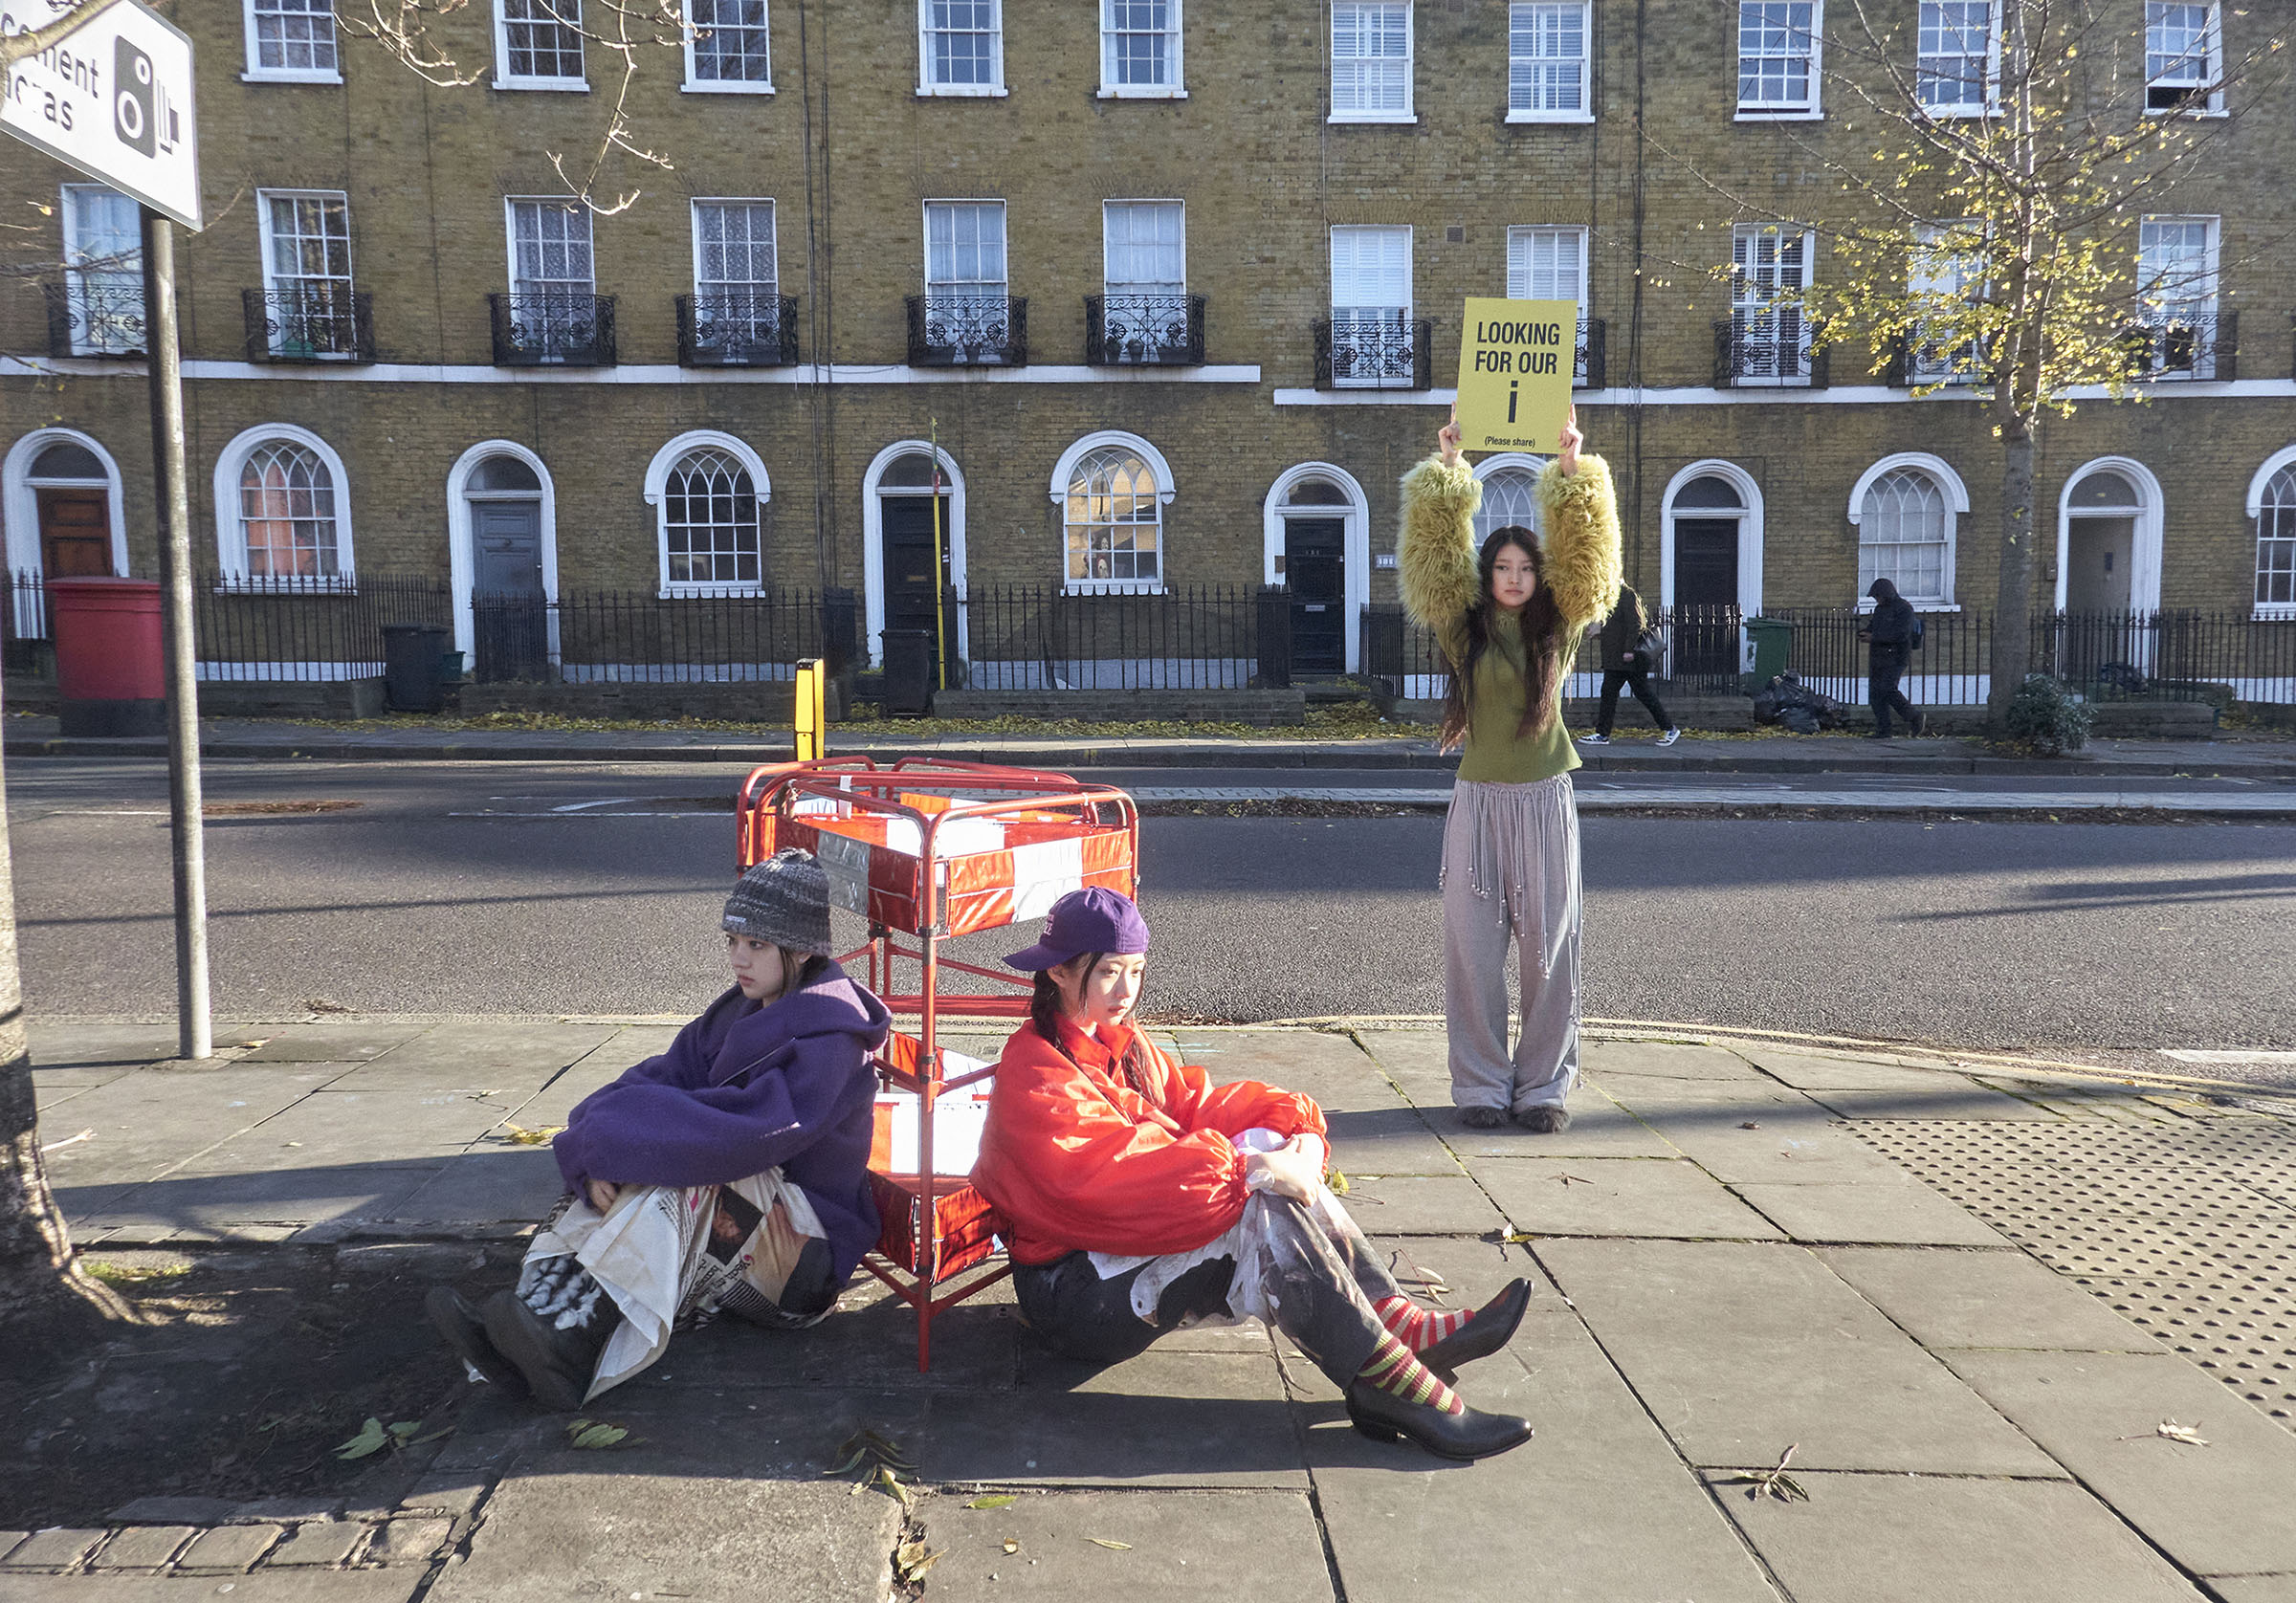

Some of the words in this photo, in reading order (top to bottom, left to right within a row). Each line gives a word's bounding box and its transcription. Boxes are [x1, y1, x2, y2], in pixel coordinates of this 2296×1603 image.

[1477, 321, 1560, 345] LOOKING
[1475, 350, 1512, 373] FOR
[1518, 351, 1557, 374] OUR
[1508, 380, 1518, 423] i
[1485, 436, 1511, 447] (Please
[1512, 437, 1535, 448] share)
